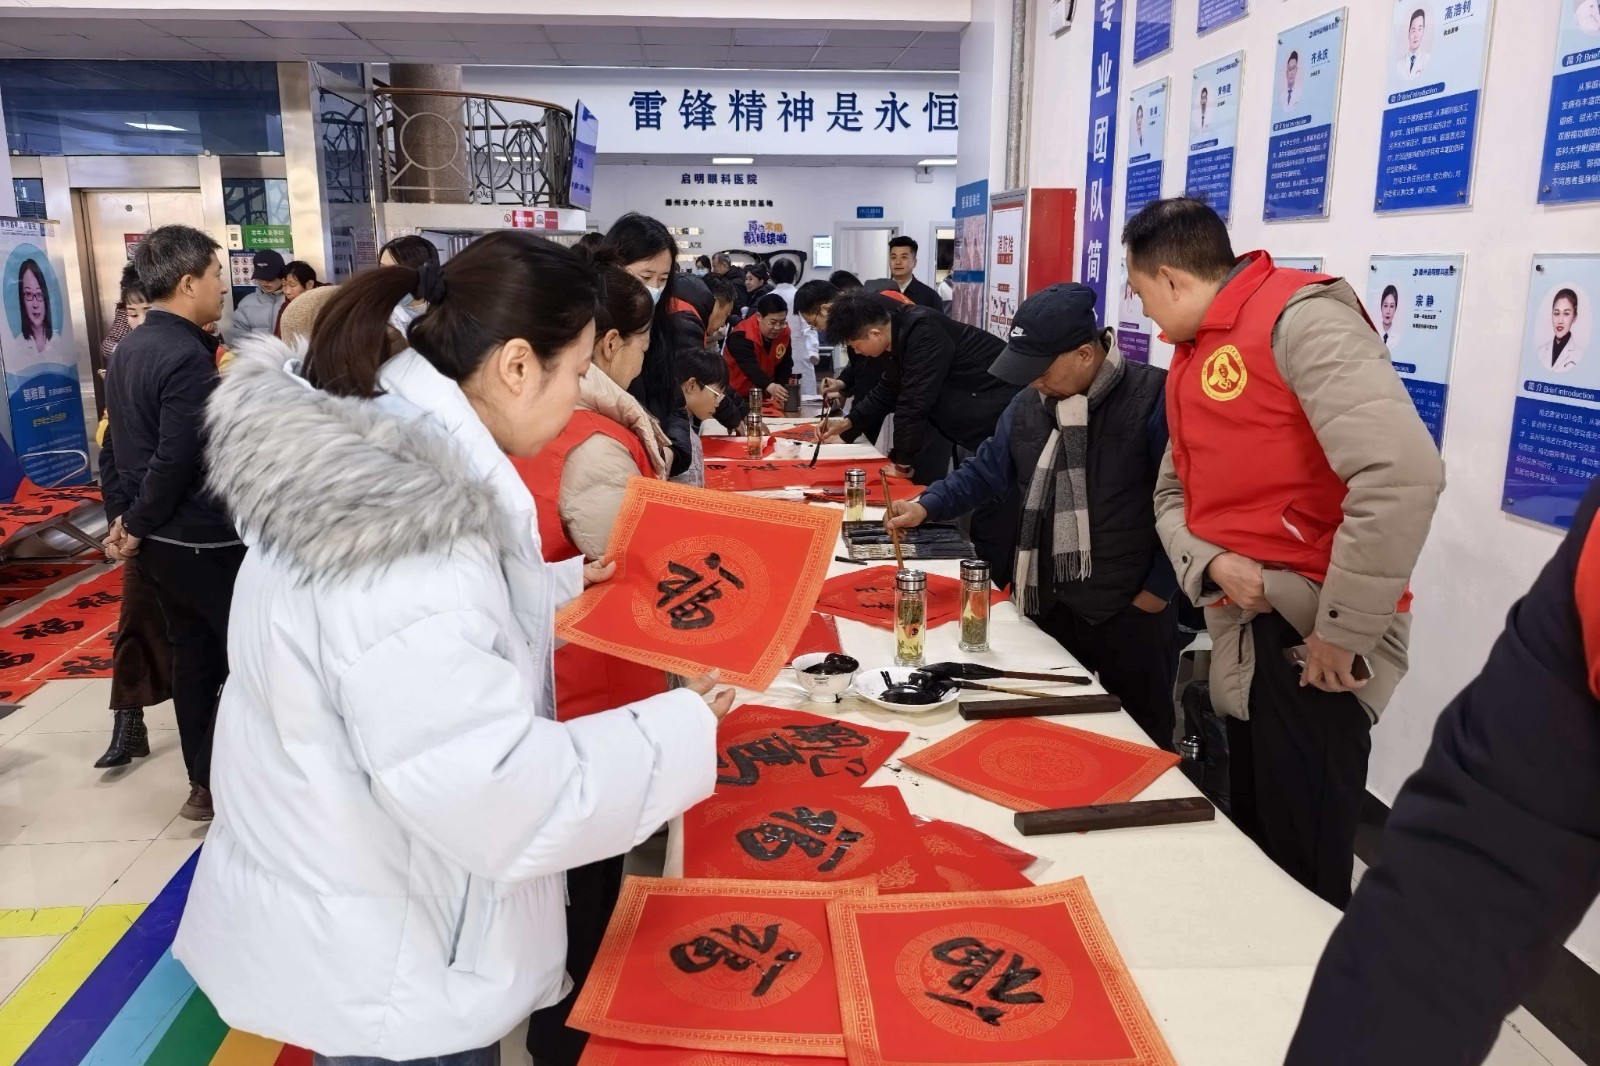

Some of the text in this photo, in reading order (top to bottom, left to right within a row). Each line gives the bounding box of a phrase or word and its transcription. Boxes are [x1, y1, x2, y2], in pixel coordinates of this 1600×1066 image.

[628, 88, 959, 133] 雷锋精神是永恒
[681, 173, 758, 185] 启明眼科医院
[1086, 0, 1114, 322] 专业团队简
[1558, 386, 1595, 401] introduction
[13, 617, 85, 640] 福
[668, 922, 804, 998] 福
[922, 935, 1046, 1028] 福
